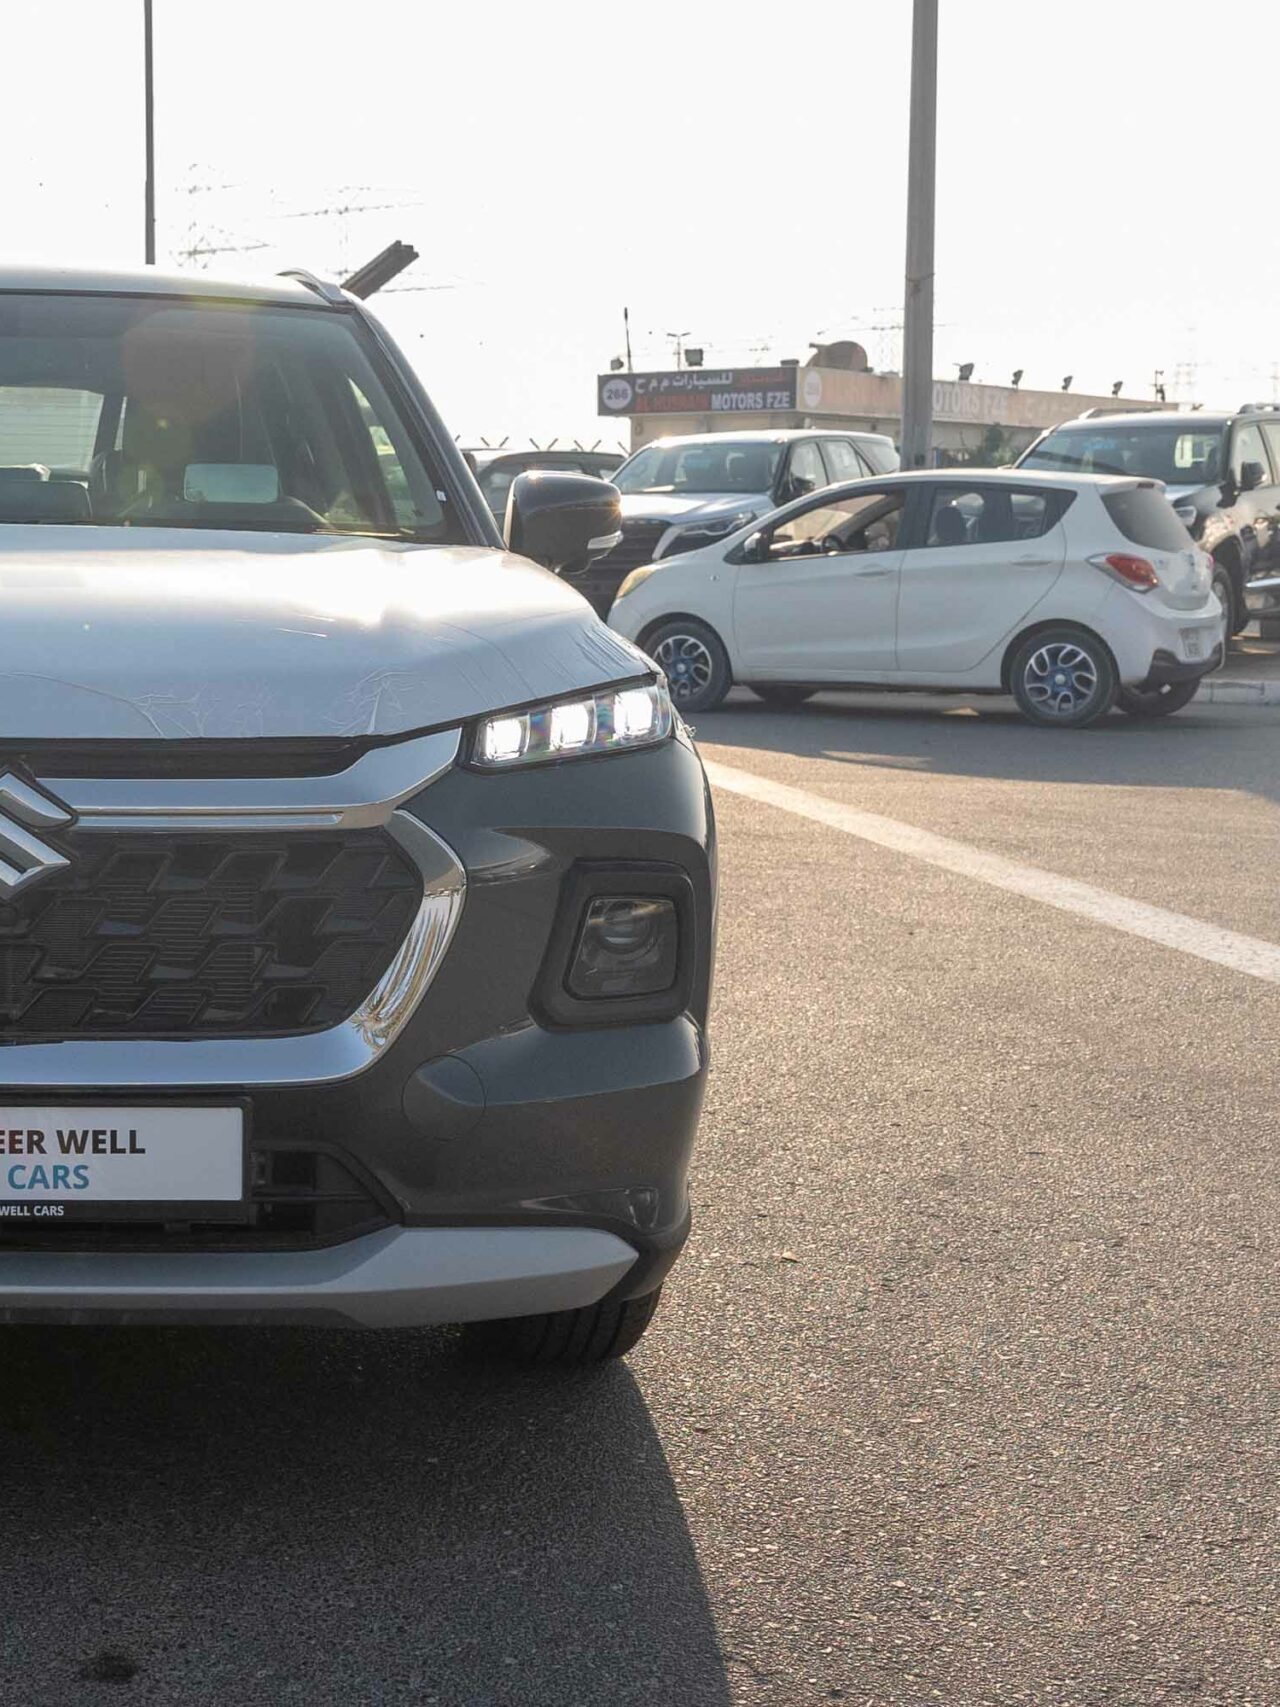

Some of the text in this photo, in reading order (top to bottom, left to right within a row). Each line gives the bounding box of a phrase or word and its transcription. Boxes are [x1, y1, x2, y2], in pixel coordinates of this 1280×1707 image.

[711, 391, 763, 410] MOTORS
[766, 391, 790, 408] FZE
[932, 382, 980, 415] OTORS
[56, 1129, 146, 1155] WELL
[7, 1164, 90, 1190] CARS
[33, 1205, 64, 1216] CARS
